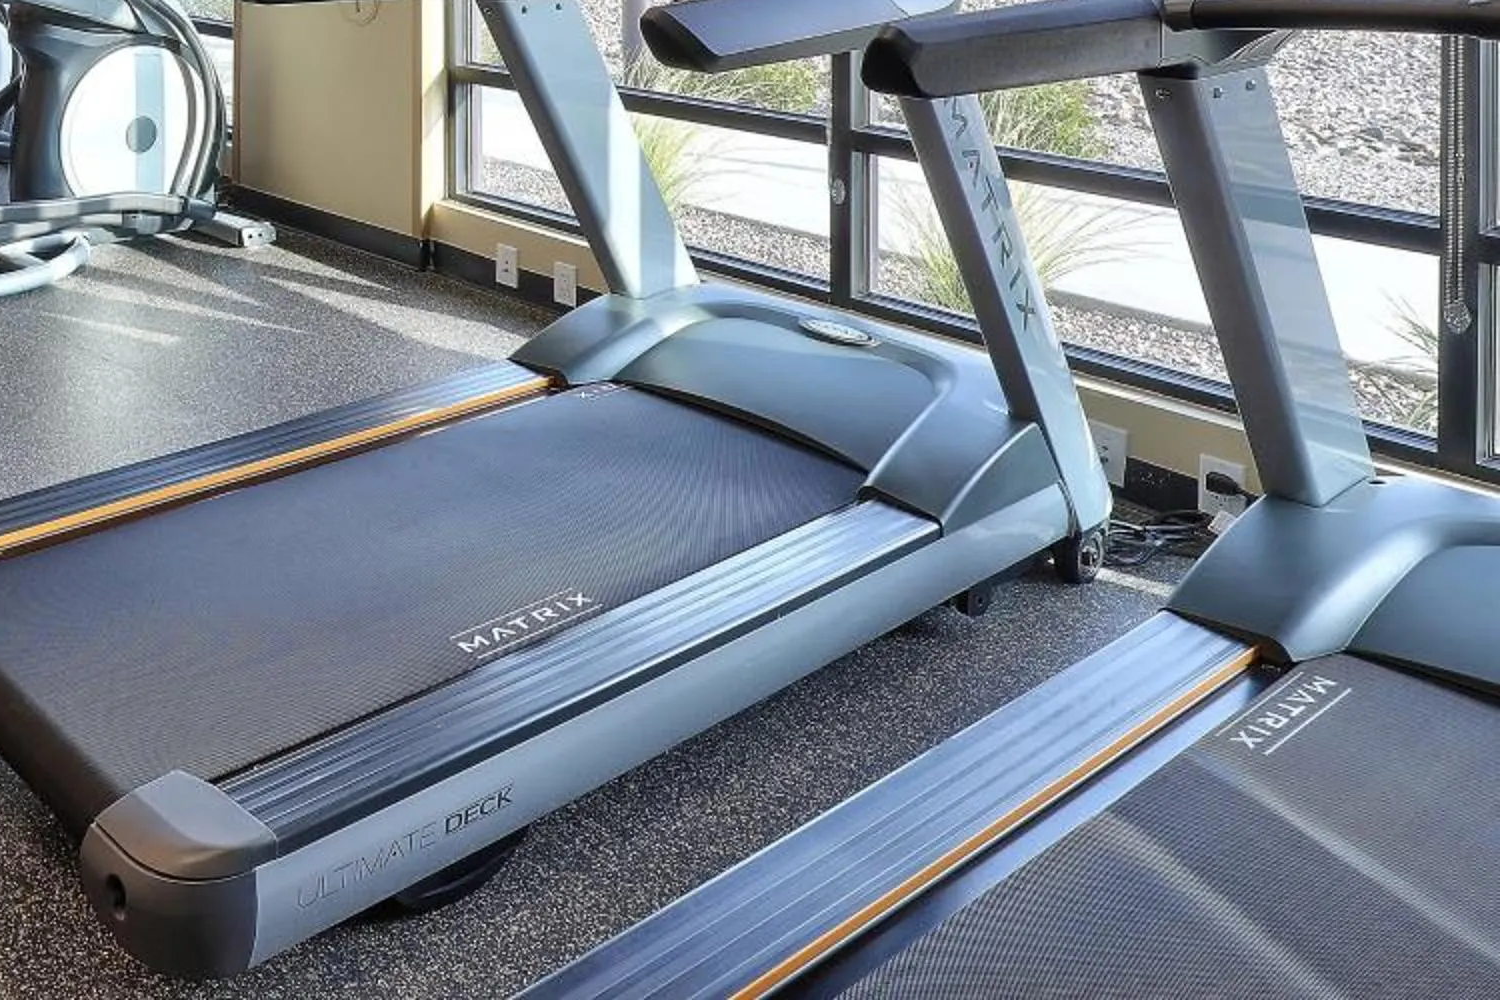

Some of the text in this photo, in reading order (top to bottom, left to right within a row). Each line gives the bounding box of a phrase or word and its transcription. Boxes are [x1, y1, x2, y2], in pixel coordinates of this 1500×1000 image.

[457, 591, 593, 654] MATRIX
[1229, 675, 1338, 750] MATRIX
[296, 783, 515, 910] ULTIMATE DECK
